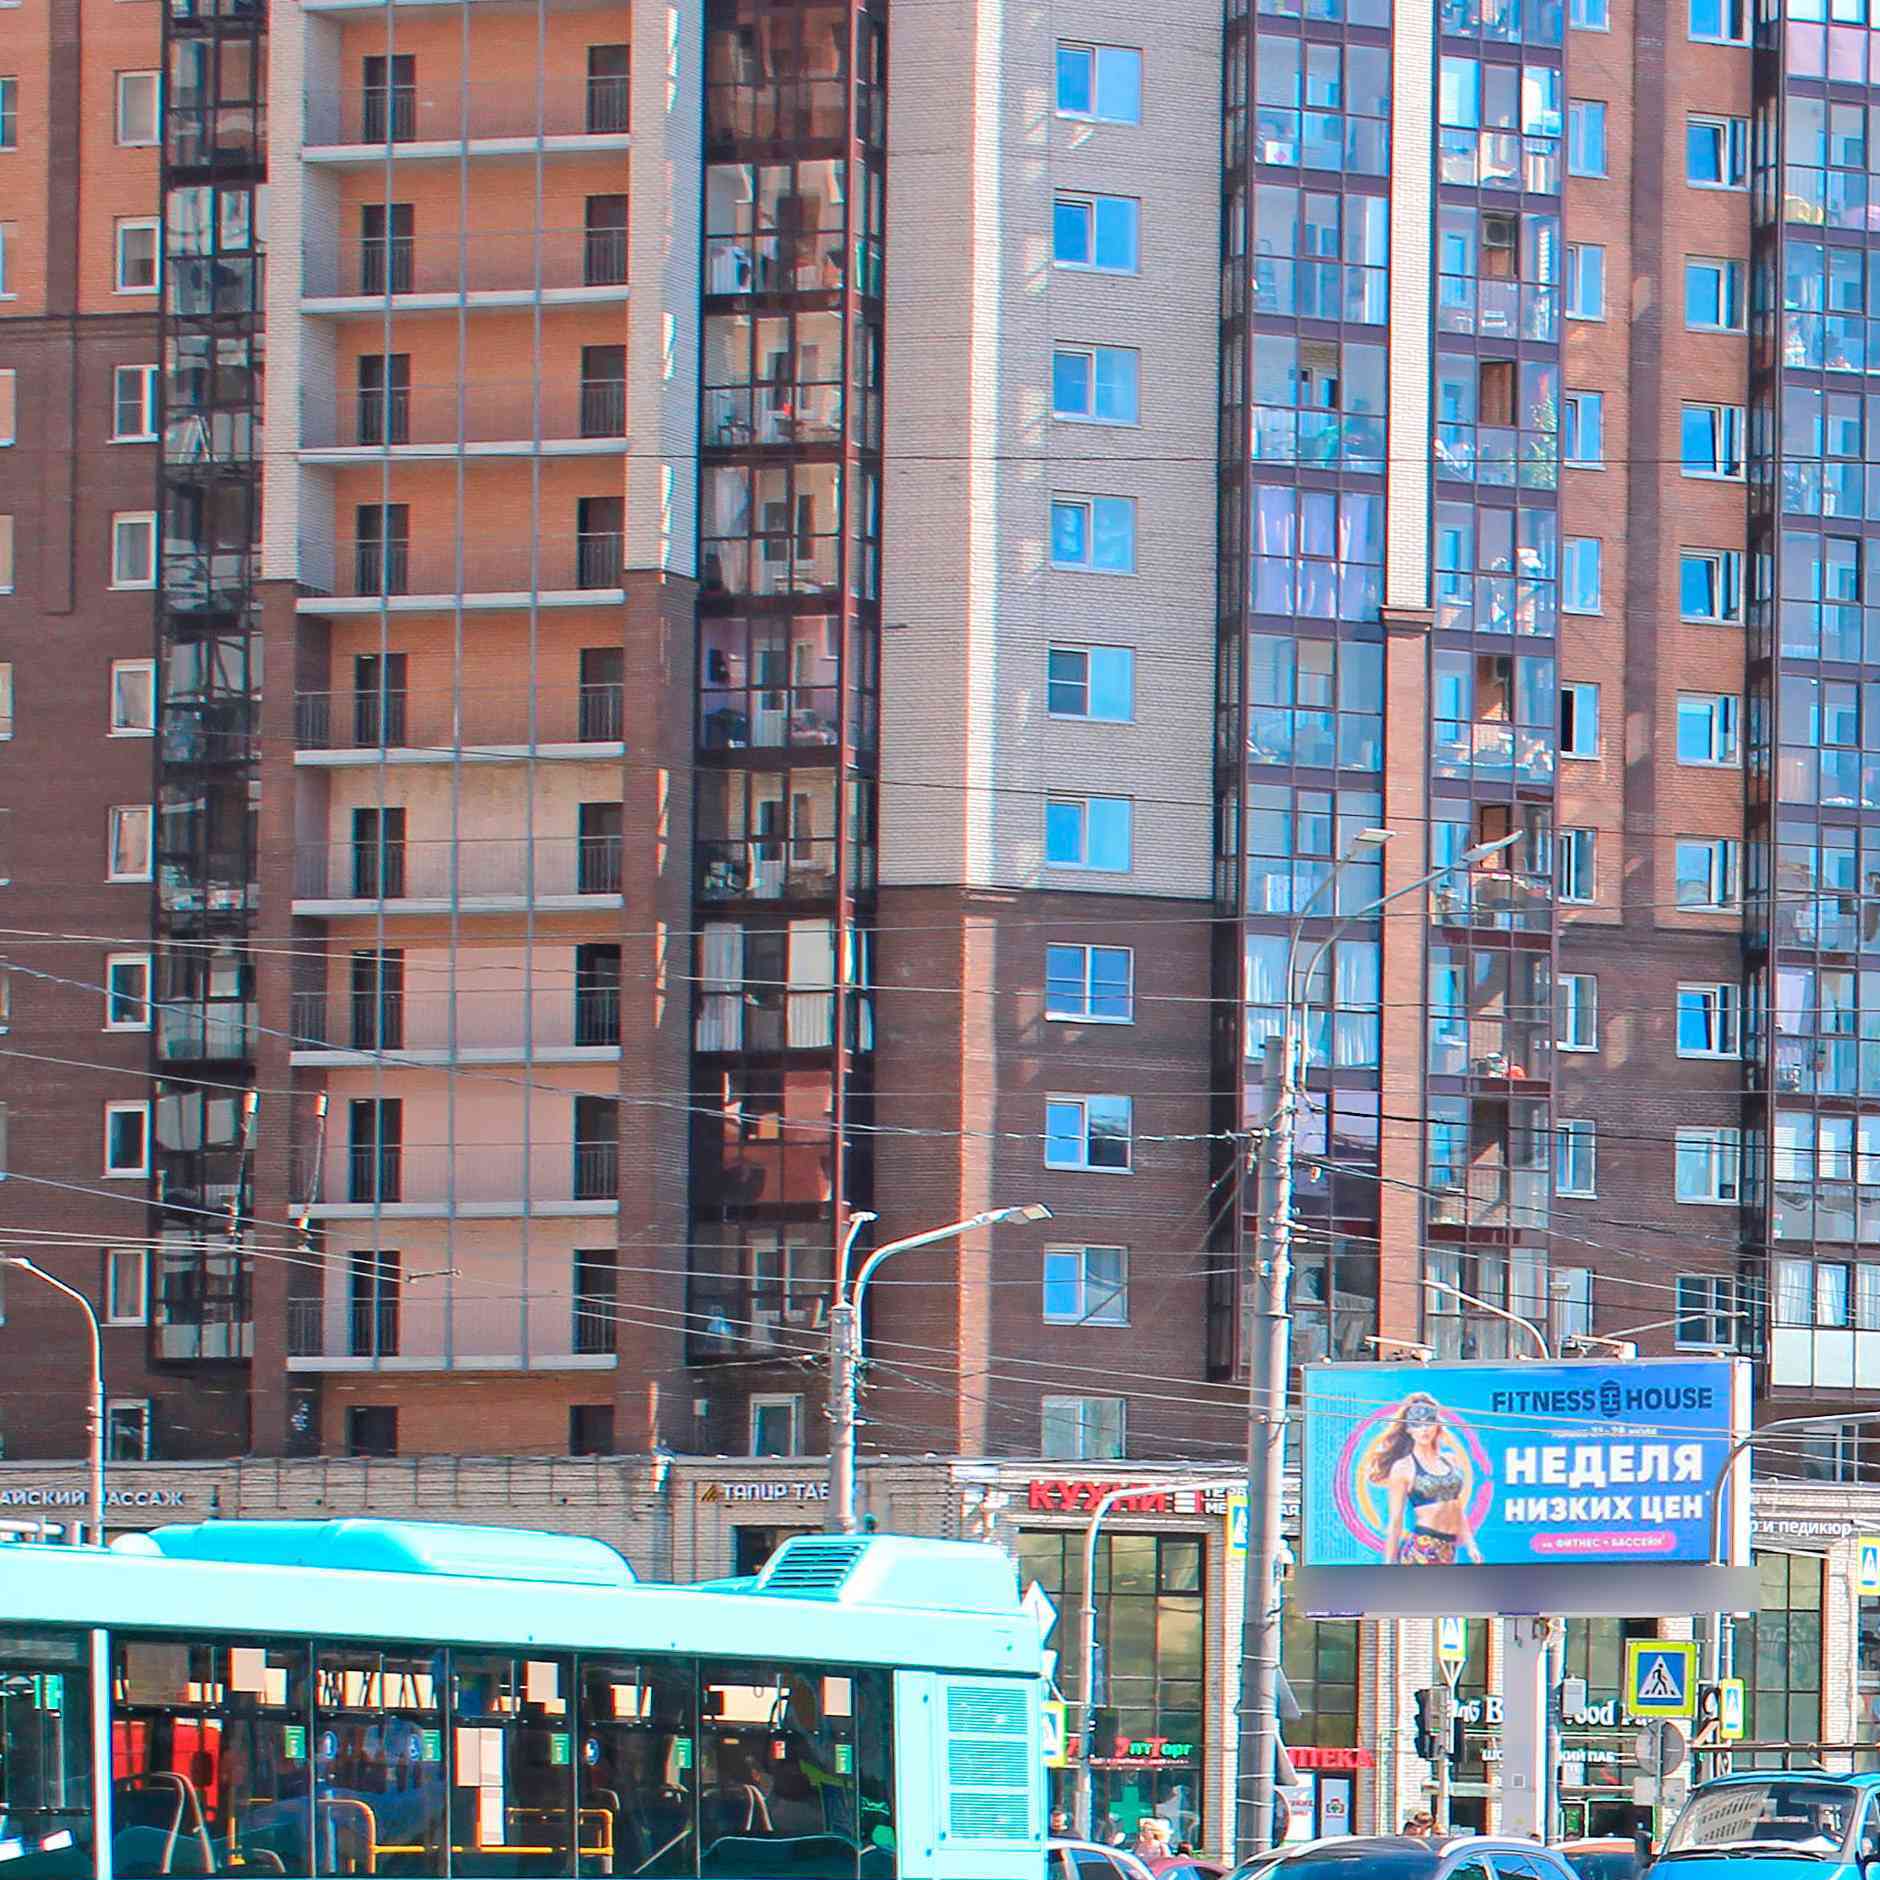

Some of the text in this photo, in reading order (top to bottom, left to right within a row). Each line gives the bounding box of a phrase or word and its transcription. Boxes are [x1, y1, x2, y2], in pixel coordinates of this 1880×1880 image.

[1492, 1387, 1713, 1413] FITNESS HOUSE
[1505, 1444, 1703, 1488] НЕДЕЛЯ
[106, 1490, 183, 1506] АССАЖ
[1504, 1494, 1703, 1523] НИЗКИХ ЦЕН
[1780, 1520, 1853, 1537] педикюр
[1555, 1538, 1600, 1548] ФИТНЕС
